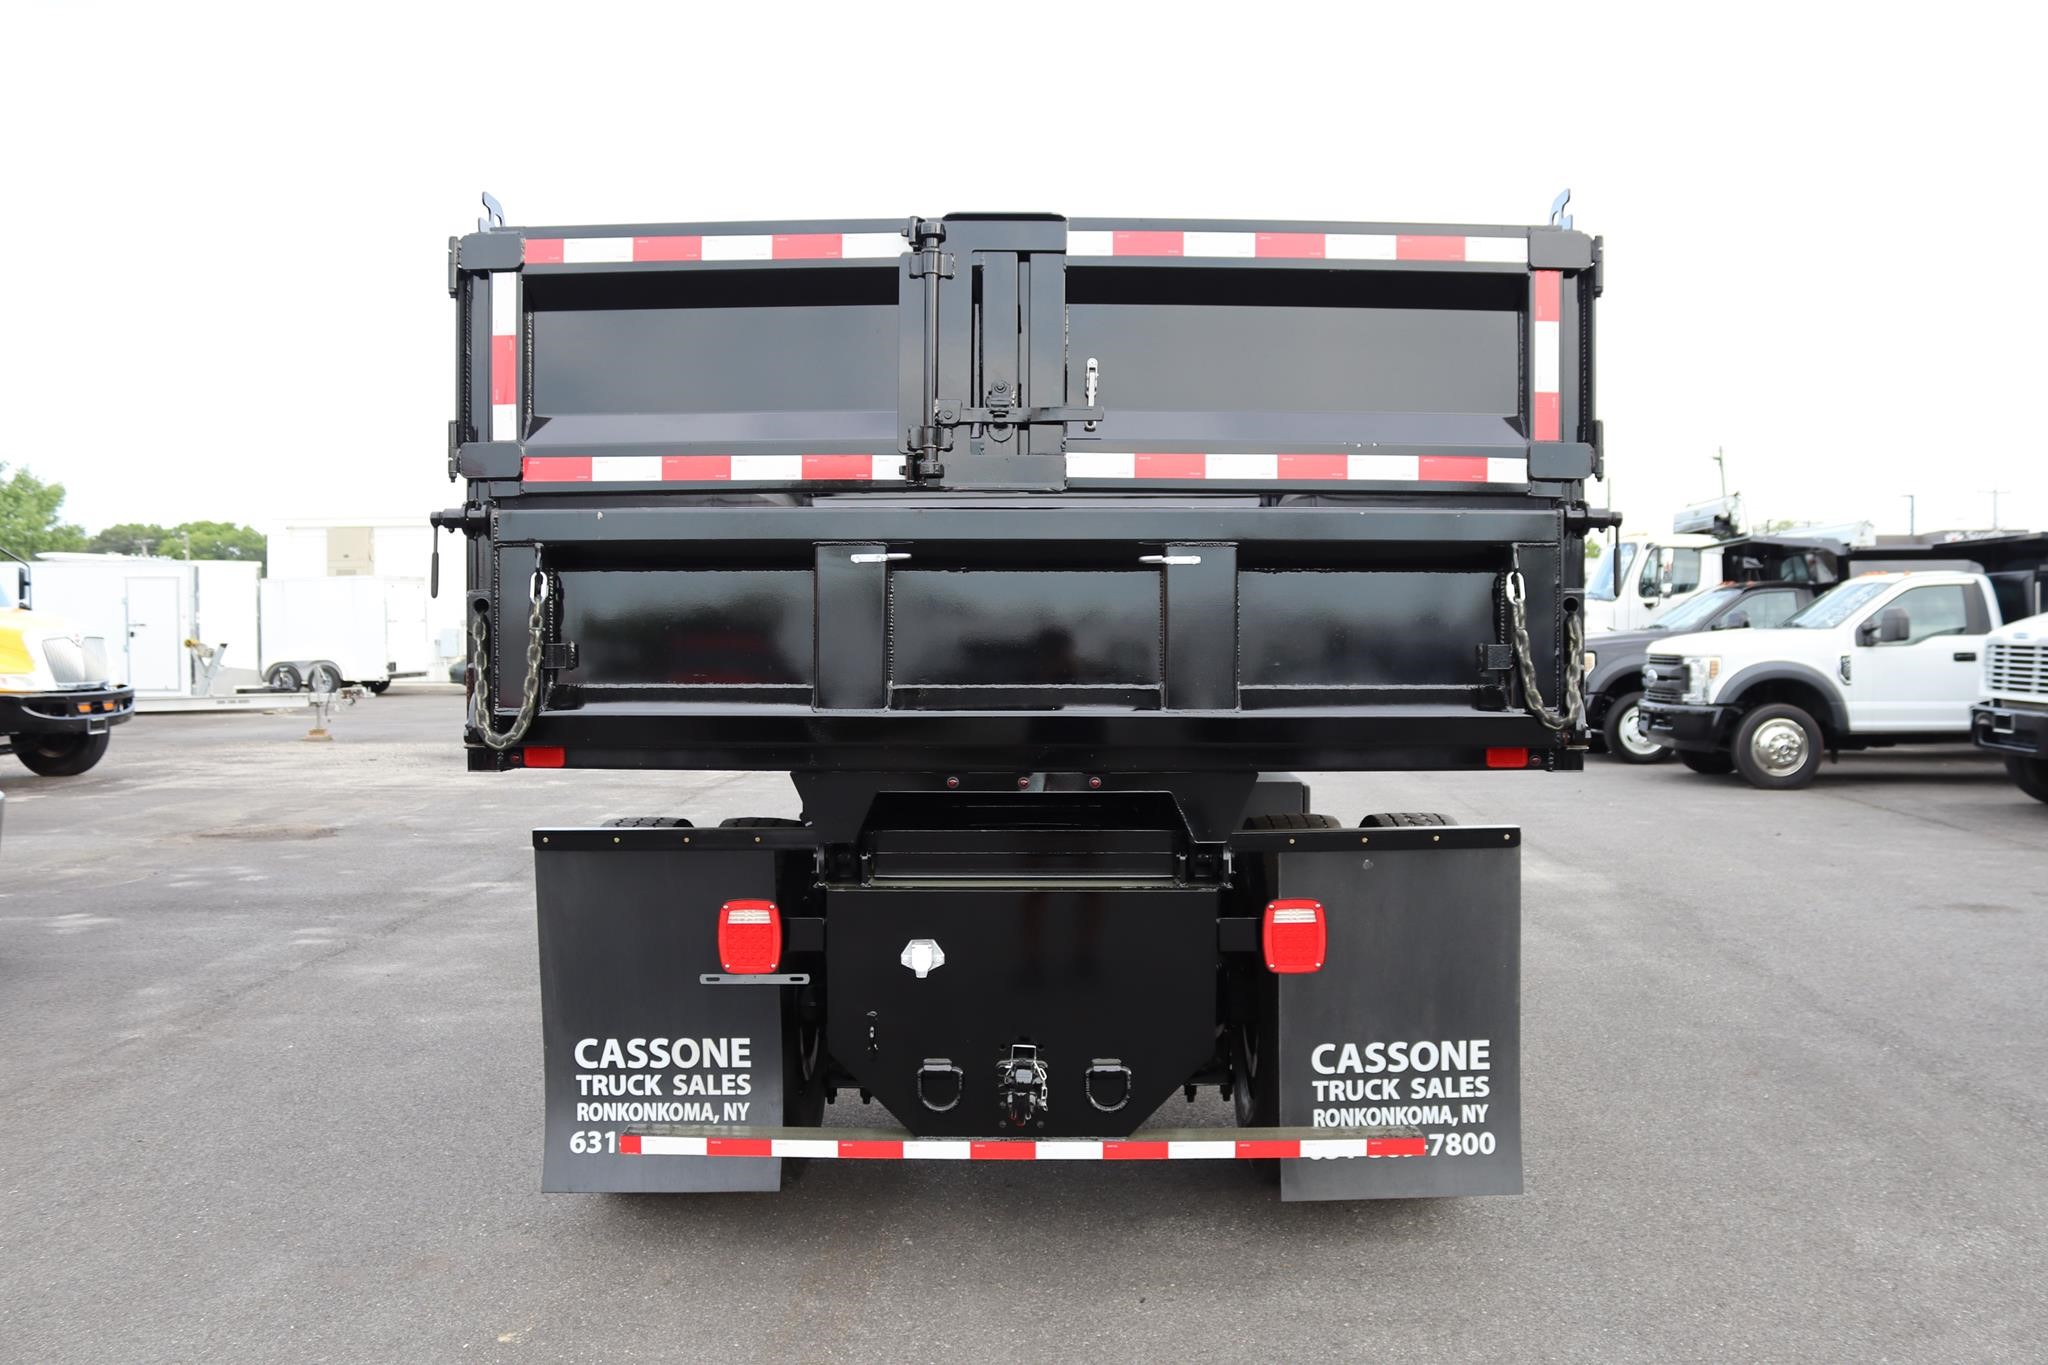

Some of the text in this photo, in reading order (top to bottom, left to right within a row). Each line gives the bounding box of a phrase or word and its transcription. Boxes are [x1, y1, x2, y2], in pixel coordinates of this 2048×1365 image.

[574, 1037, 752, 1069] CASSONE
[1311, 1039, 1491, 1075] CASSONE
[575, 1073, 752, 1097] TRUCK SALES
[1311, 1075, 1491, 1103] TRUCK SALES
[576, 1101, 751, 1125] RONKONKOMA, NY
[1312, 1103, 1489, 1128] RONKONKOMA, NY
